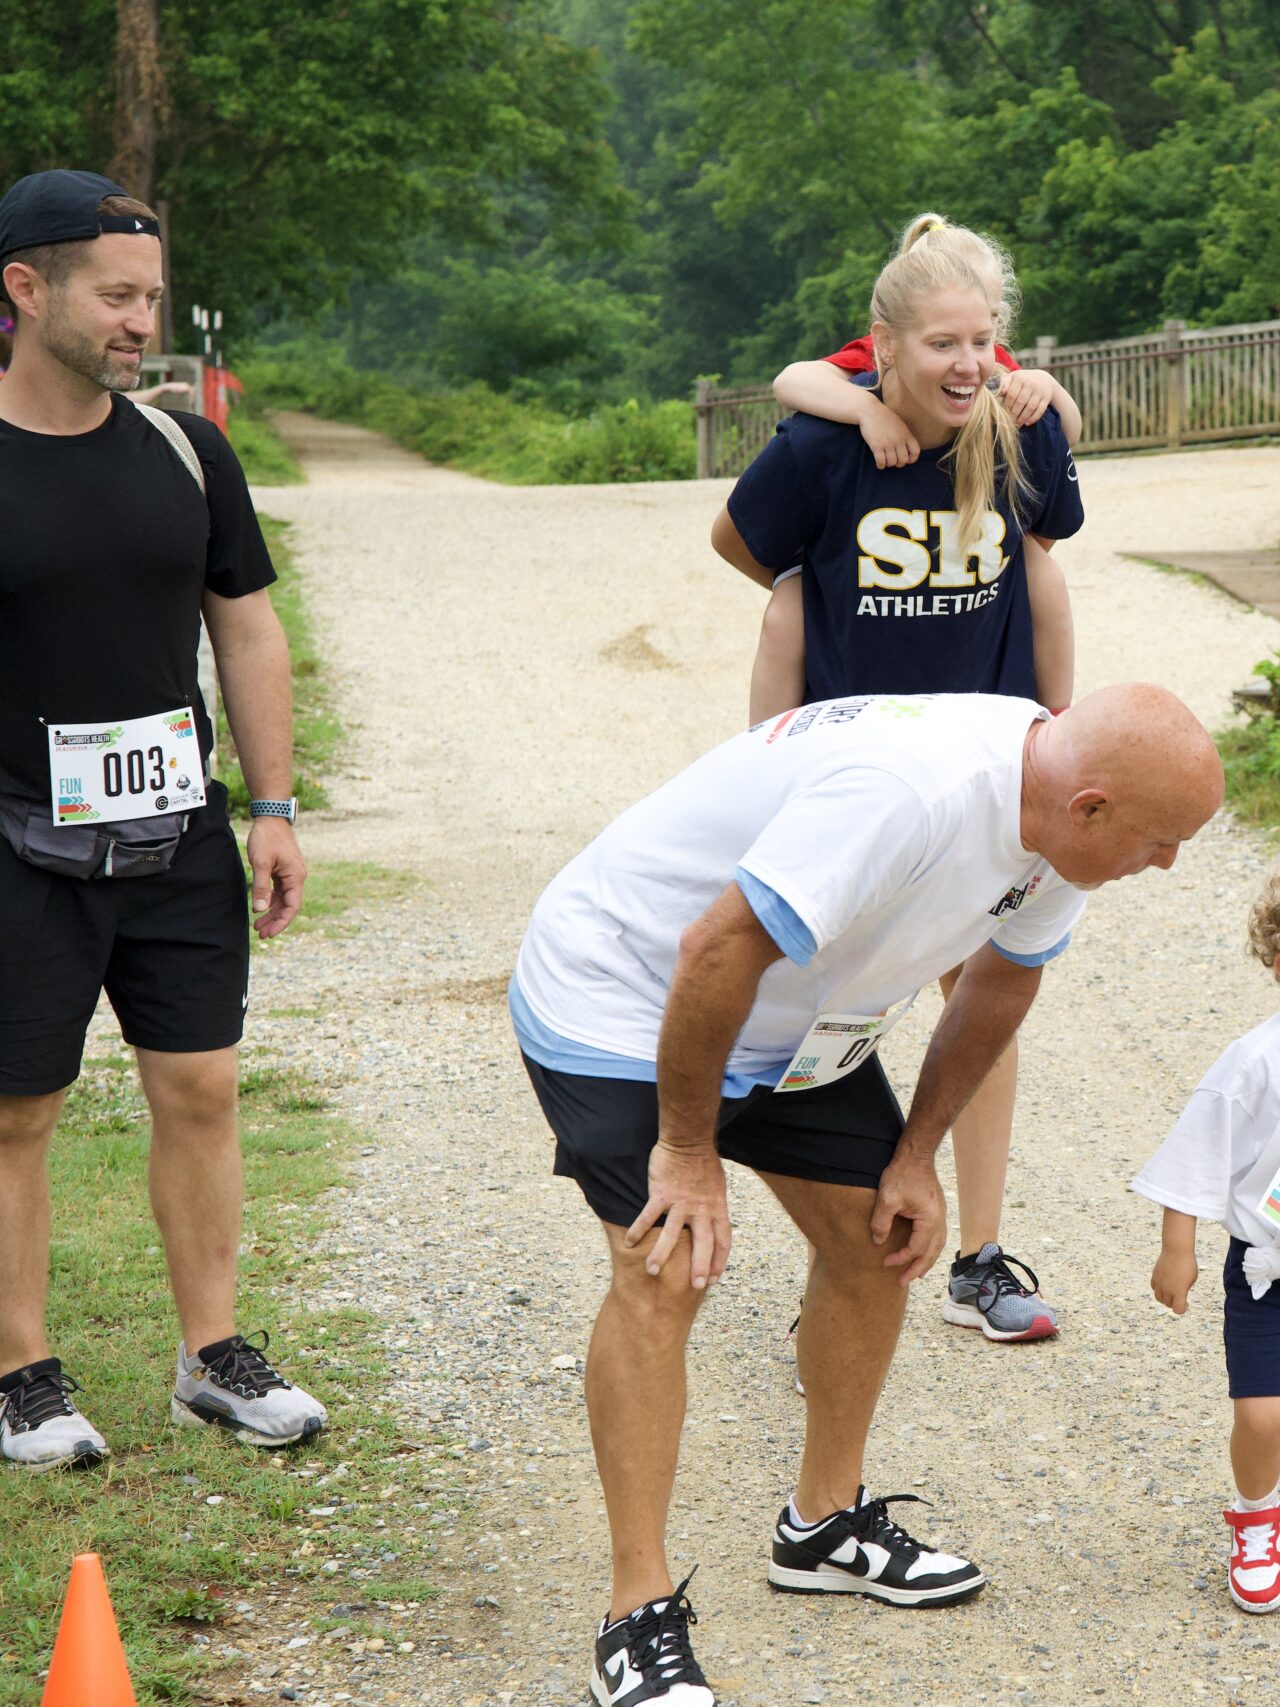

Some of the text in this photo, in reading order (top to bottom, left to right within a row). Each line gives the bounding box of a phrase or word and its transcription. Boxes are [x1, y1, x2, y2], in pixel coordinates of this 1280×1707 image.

[856, 507, 1010, 590] SR
[856, 582, 999, 617] ATHLETICS
[59, 778, 82, 795] FUN
[103, 745, 166, 797] 003
[795, 1056, 820, 1069] FUN
